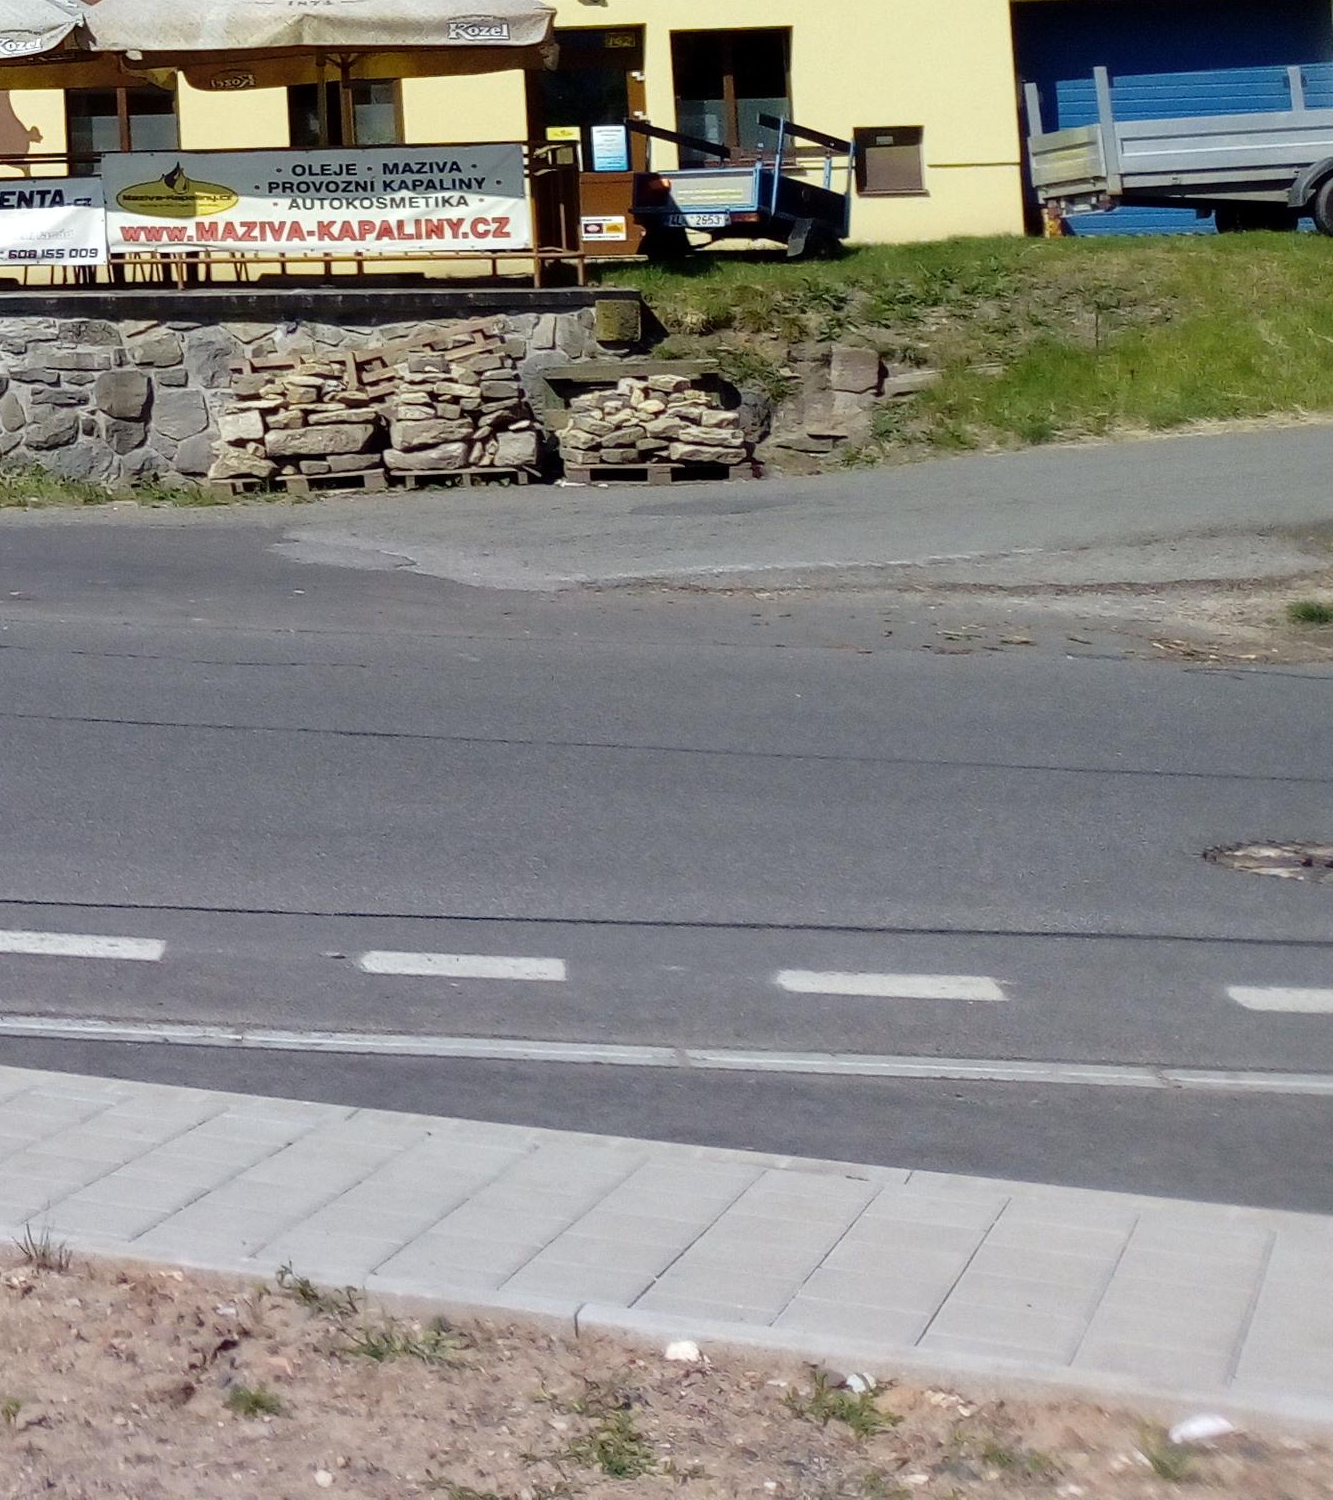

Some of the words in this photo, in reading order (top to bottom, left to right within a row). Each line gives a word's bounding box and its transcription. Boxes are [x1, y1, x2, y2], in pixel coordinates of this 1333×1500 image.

[447, 21, 510, 40] Kozel
[291, 163, 358, 177] OLEJE
[382, 161, 462, 175] MAZIVA
[268, 176, 375, 194] PROVOZNÍ
[382, 177, 486, 192] KAPALINY
[288, 195, 470, 211] AUTOKOSMETIKA
[120, 217, 511, 242] www.MAZIVA-KAPALINY.CZ
[8, 249, 38, 259] 608
[41, 249, 65, 259] 155
[68, 248, 99, 259] 009
